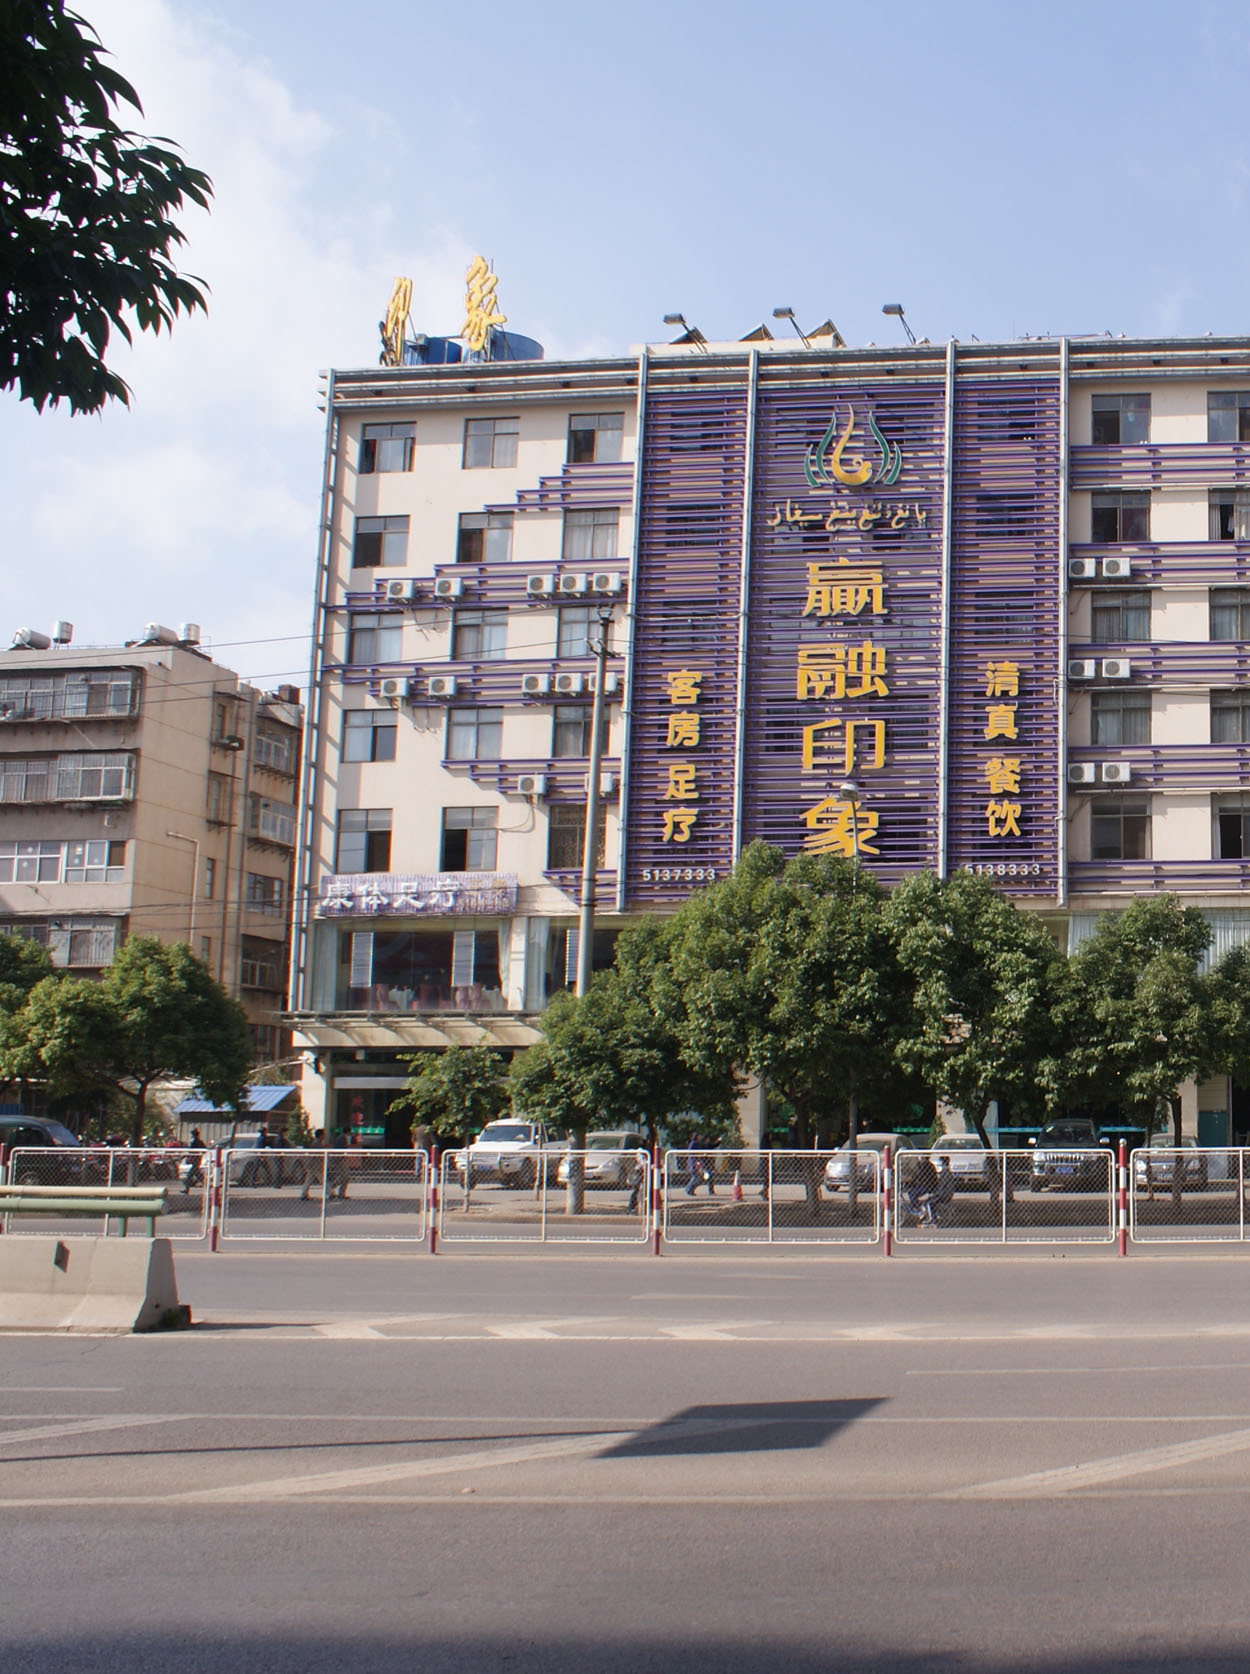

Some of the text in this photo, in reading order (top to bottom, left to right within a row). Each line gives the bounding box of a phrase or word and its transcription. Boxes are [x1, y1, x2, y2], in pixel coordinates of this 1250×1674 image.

[663, 669, 702, 842] 客房足疗
[797, 558, 890, 856] 赢融印象
[984, 662, 1022, 838] 清真餐饮
[322, 878, 460, 908] 康体足疗
[643, 869, 716, 881] 5137333
[966, 864, 1040, 876] 5138333
